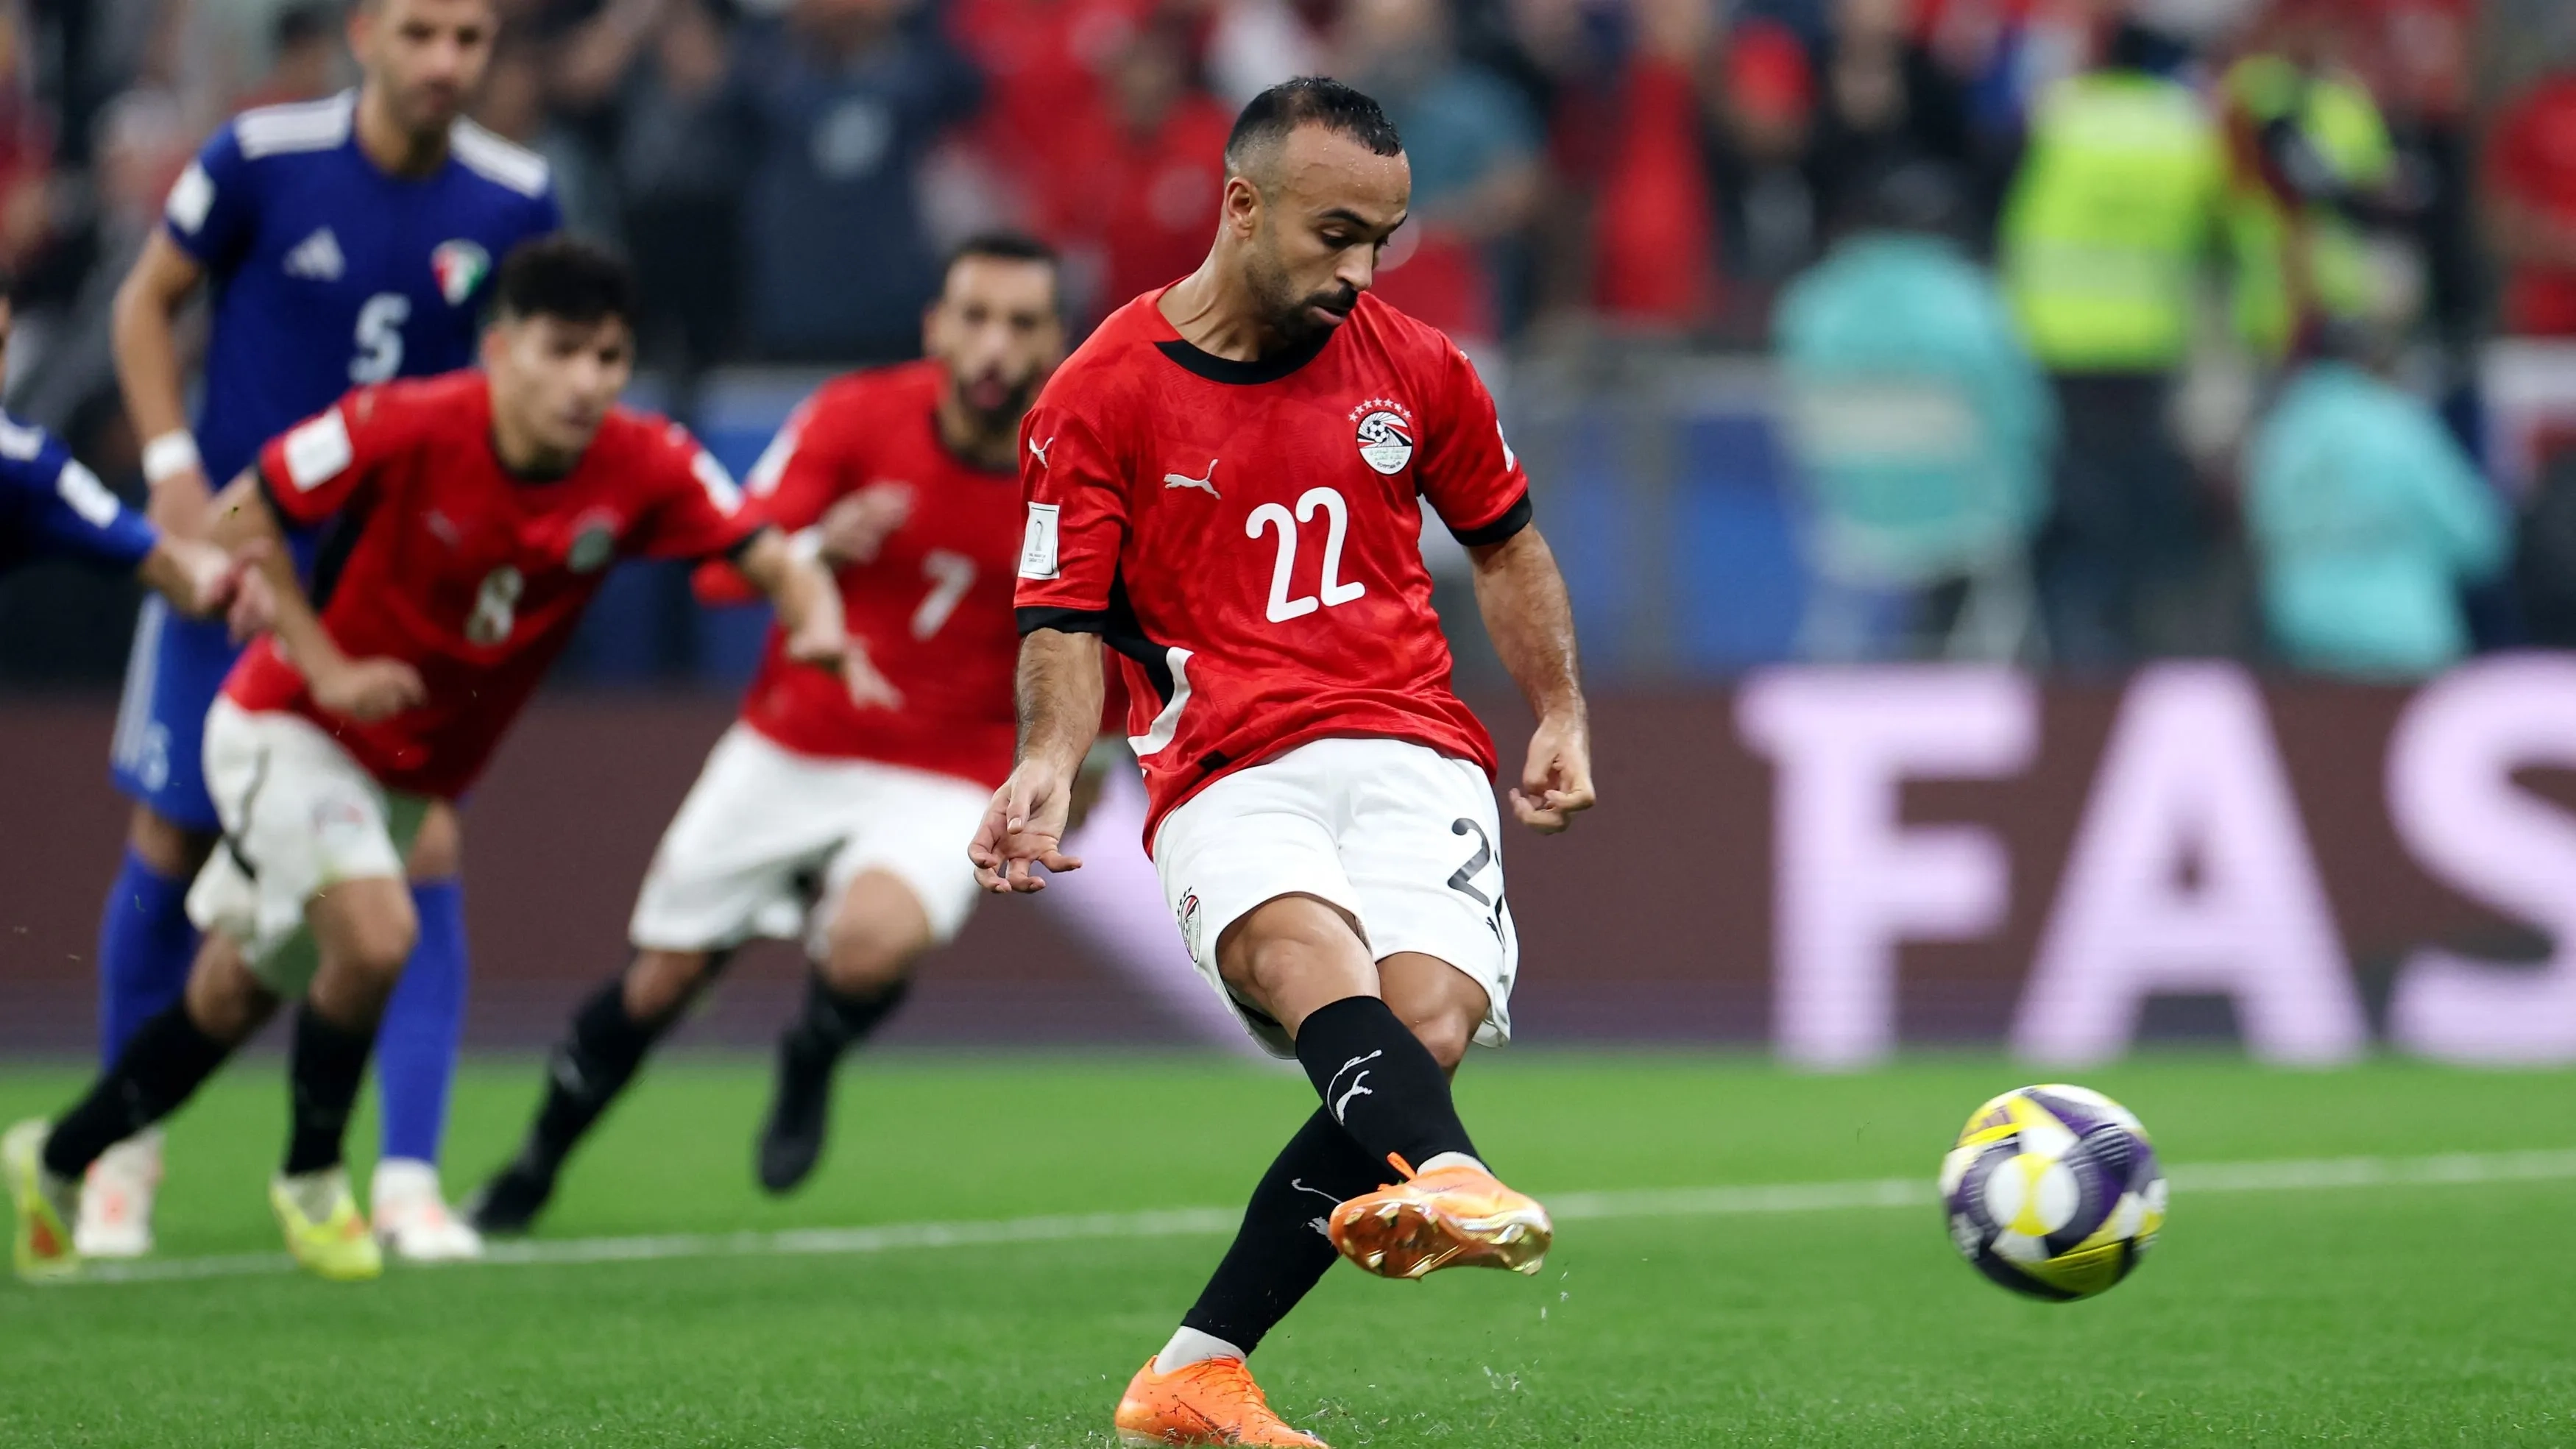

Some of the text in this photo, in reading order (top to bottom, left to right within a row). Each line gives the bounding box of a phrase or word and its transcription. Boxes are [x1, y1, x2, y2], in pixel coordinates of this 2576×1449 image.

[348, 293, 412, 384] 5
[910, 549, 977, 640] 7
[1245, 486, 1367, 623] 22
[467, 567, 524, 645] 8
[1447, 818, 1504, 918] 2
[1735, 655, 2576, 1071] FAS
